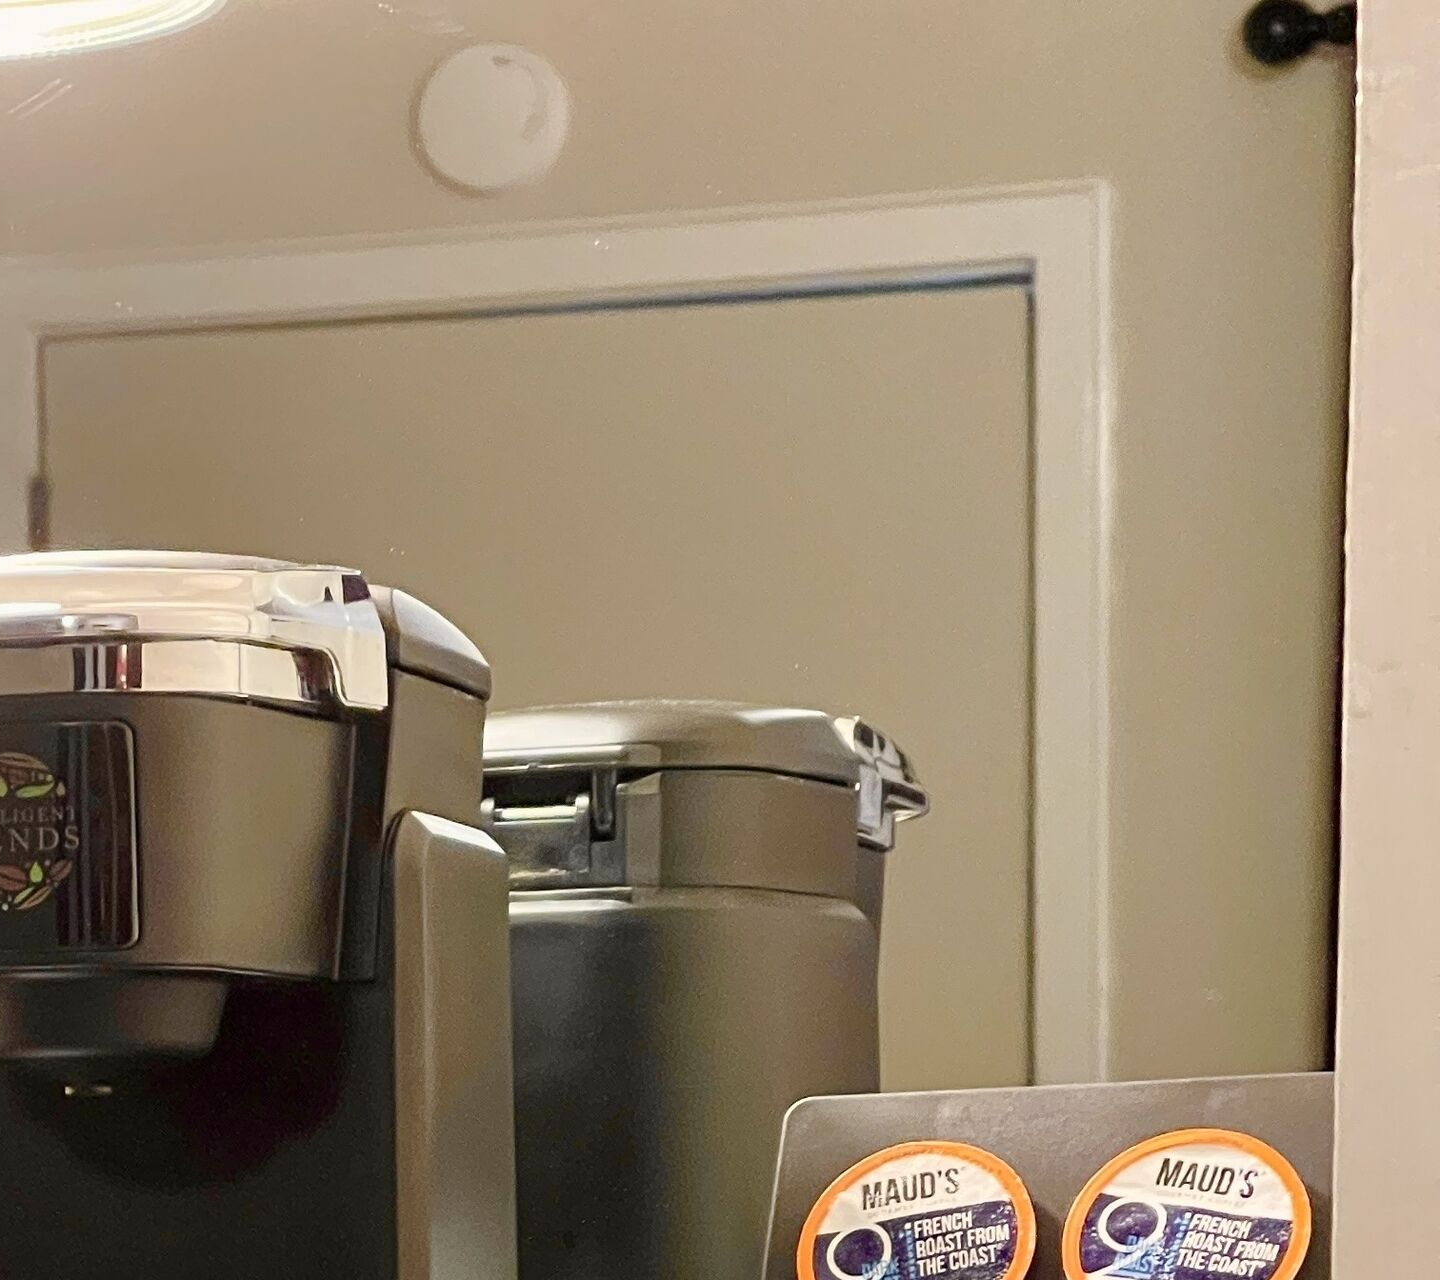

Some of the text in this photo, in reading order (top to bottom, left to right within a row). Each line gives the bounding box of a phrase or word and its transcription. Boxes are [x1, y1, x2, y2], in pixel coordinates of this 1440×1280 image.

[862, 1167, 960, 1211] MAUD'S
[1156, 1157, 1259, 1199] MAUD'S
[913, 1210, 973, 1239] FRENCH
[1189, 1213, 1253, 1239] FRENCH
[915, 1223, 1010, 1259] ROAST FROM
[1182, 1229, 1281, 1262] ROAST FROM
[916, 1257, 947, 1277] THE
[1176, 1248, 1205, 1269] THE
